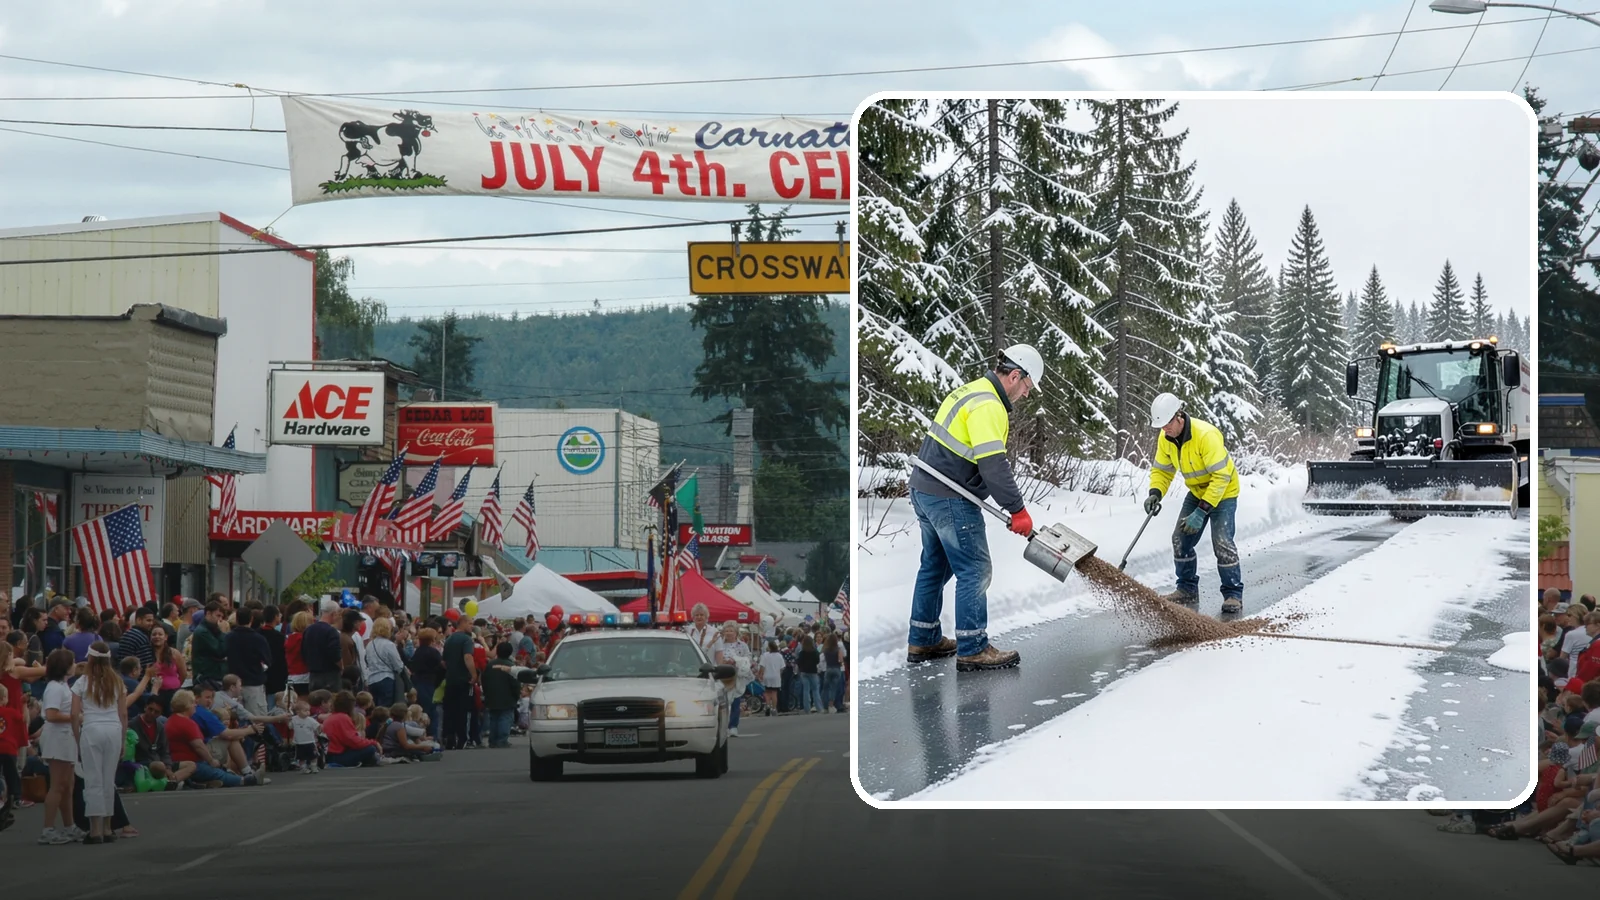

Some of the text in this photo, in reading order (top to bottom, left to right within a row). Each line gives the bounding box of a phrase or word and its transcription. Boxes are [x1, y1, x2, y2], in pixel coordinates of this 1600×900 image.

[481, 141, 605, 192] JULY
[632, 150, 746, 198] 4th.
[696, 254, 851, 280] CROSSWA
[282, 380, 373, 420] ACE
[405, 409, 452, 422] CEDAR
[283, 421, 371, 436] Hardware
[95, 485, 124, 495] Vincent
[126, 486, 136, 495] de
[137, 486, 155, 495] Paul
[81, 503, 154, 522] THT
[212, 516, 331, 536] HARDARE
[688, 526, 741, 535] CRNATION
[699, 535, 730, 543] GLASS
